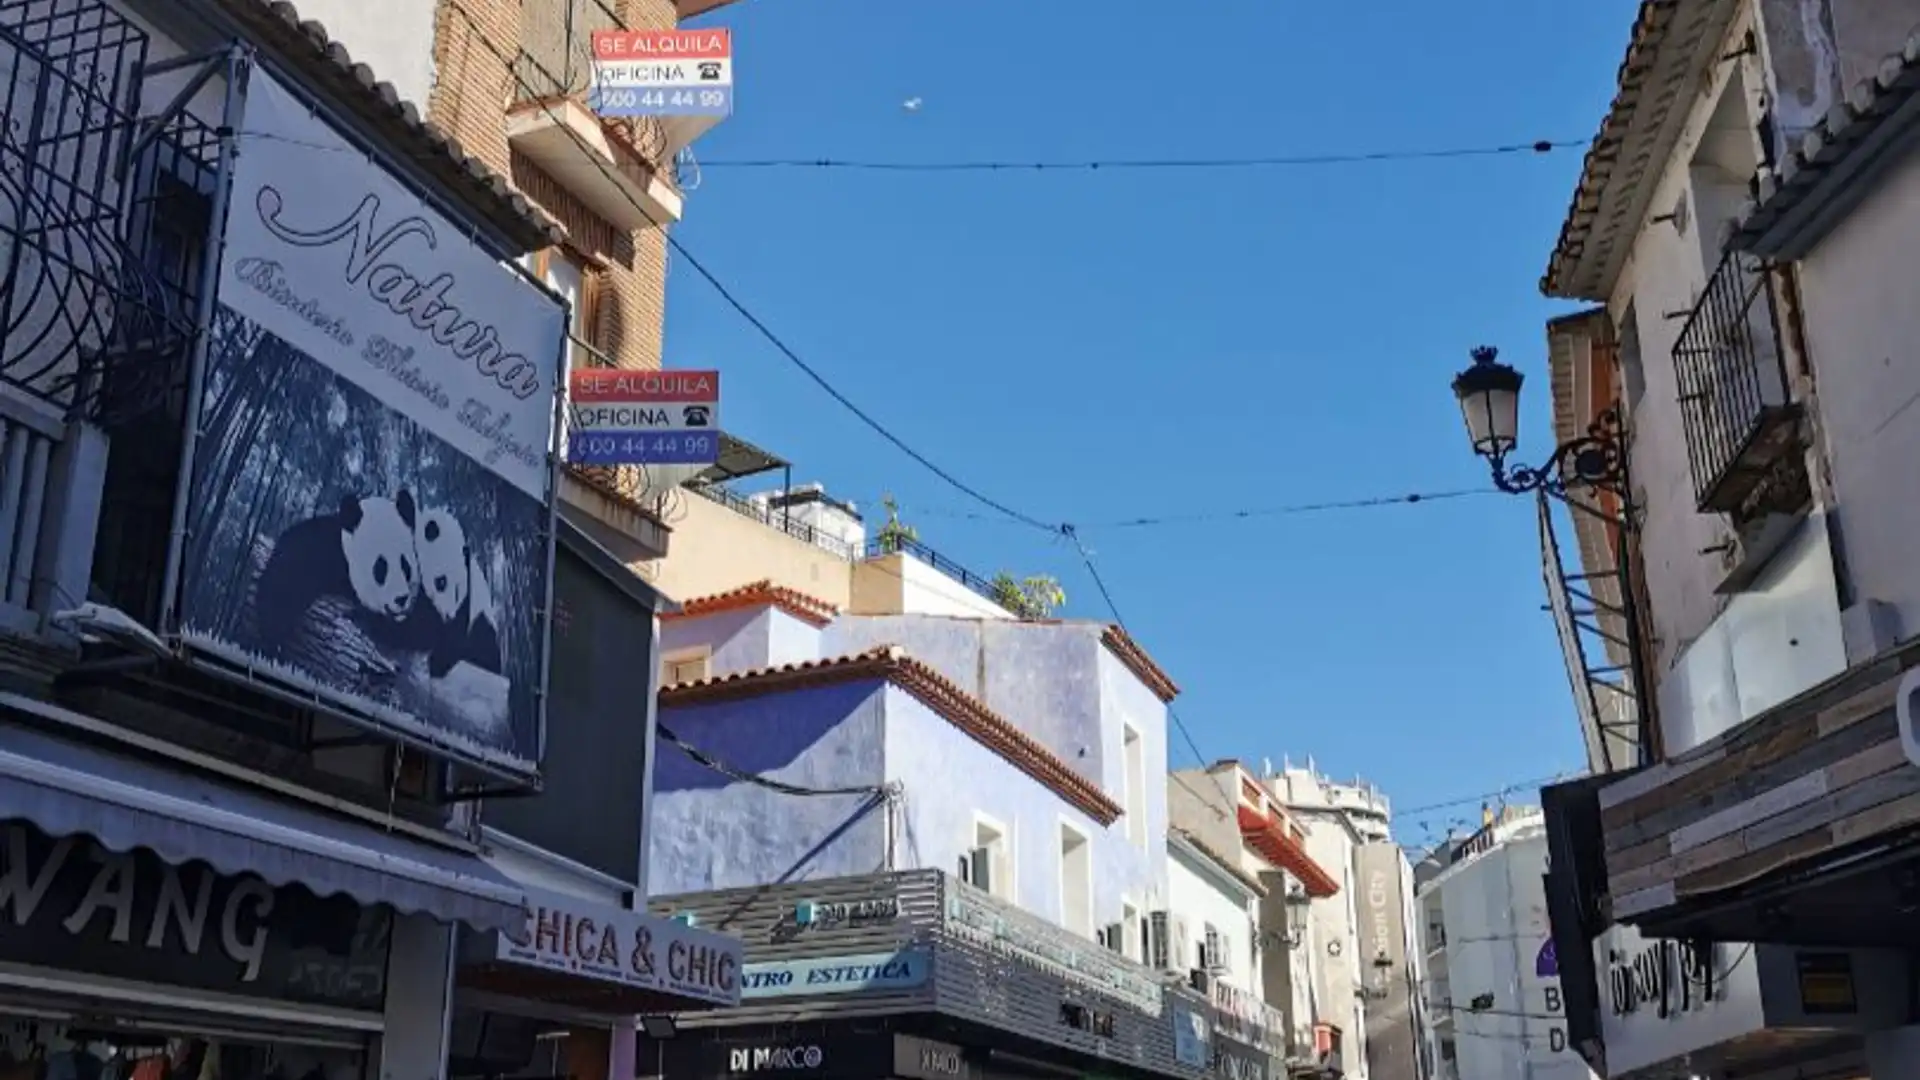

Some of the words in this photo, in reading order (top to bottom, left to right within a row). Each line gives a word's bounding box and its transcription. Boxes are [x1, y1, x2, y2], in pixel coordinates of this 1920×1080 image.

[599, 37, 626, 54] SE
[632, 34, 722, 53] ALQUILA
[598, 64, 684, 80] OFICINA
[642, 89, 665, 107] 44
[670, 89, 694, 107] 44
[255, 184, 540, 400] Natura
[580, 377, 608, 394] SE
[614, 375, 710, 394] ALQUILA
[579, 407, 670, 427] OFICINA
[622, 437, 645, 455] 44
[651, 437, 677, 454] 44
[684, 435, 710, 455] 99
[632, 925, 655, 976] &
[668, 939, 736, 991] CHIC
[805, 961, 912, 985] ESTETICA
[730, 1047, 749, 1072] DI
[754, 1045, 822, 1072] MARCO
